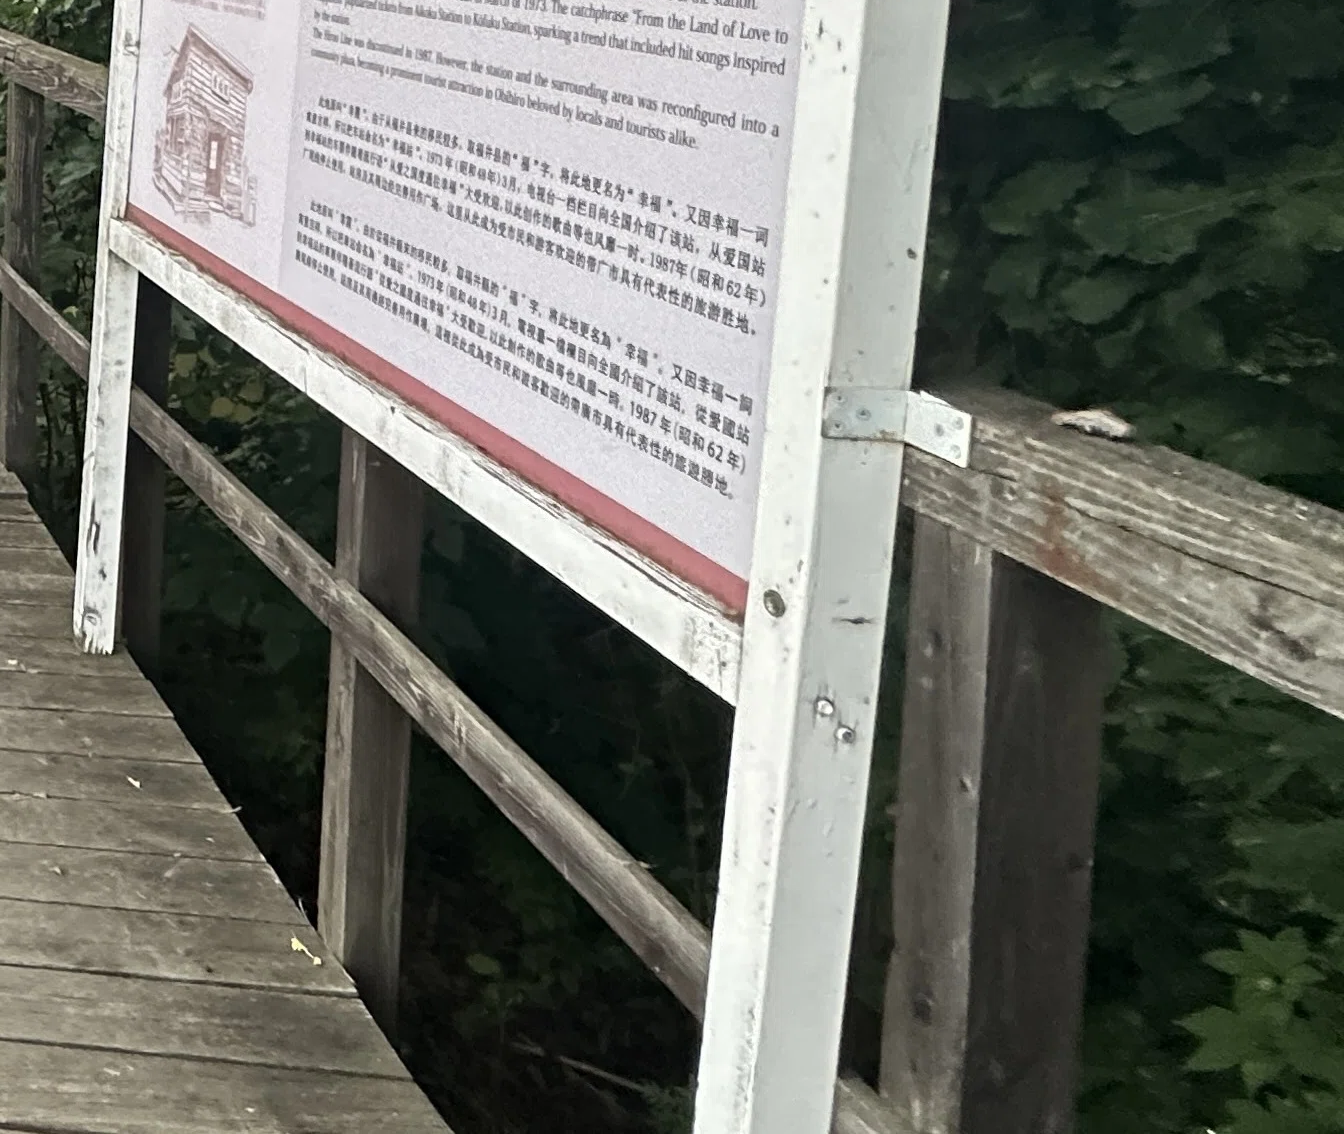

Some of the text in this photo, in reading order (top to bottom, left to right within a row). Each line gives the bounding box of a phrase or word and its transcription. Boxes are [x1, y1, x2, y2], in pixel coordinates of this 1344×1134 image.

[533, 24, 572, 45] sparking
[572, 31, 579, 42] a
[580, 30, 606, 47] trend
[608, 33, 628, 50] that
[629, 35, 676, 58] included
[677, 42, 693, 61] hit
[695, 50, 730, 70] songs
[732, 51, 786, 76] inspired
[570, 3, 629, 23] catchphrase
[667, 13, 685, 30] the
[689, 15, 719, 35] Land
[722, 20, 737, 37] of
[739, 21, 770, 42] Love
[774, 28, 789, 44] to
[485, 63, 513, 79] station
[515, 69, 531, 83] and
[533, 71, 548, 87] the
[550, 78, 608, 104] surrounding
[610, 91, 634, 106] area
[637, 96, 657, 111] was
[661, 101, 737, 128] reconfigured
[740, 112, 767, 135] into
[770, 124, 780, 137] a
[526, 94, 561, 115] beloved
[561, 102, 573, 123] by
[575, 105, 603, 126] locals
[604, 114, 624, 131] and
[625, 119, 665, 141] tourists
[668, 128, 697, 149] alike.
